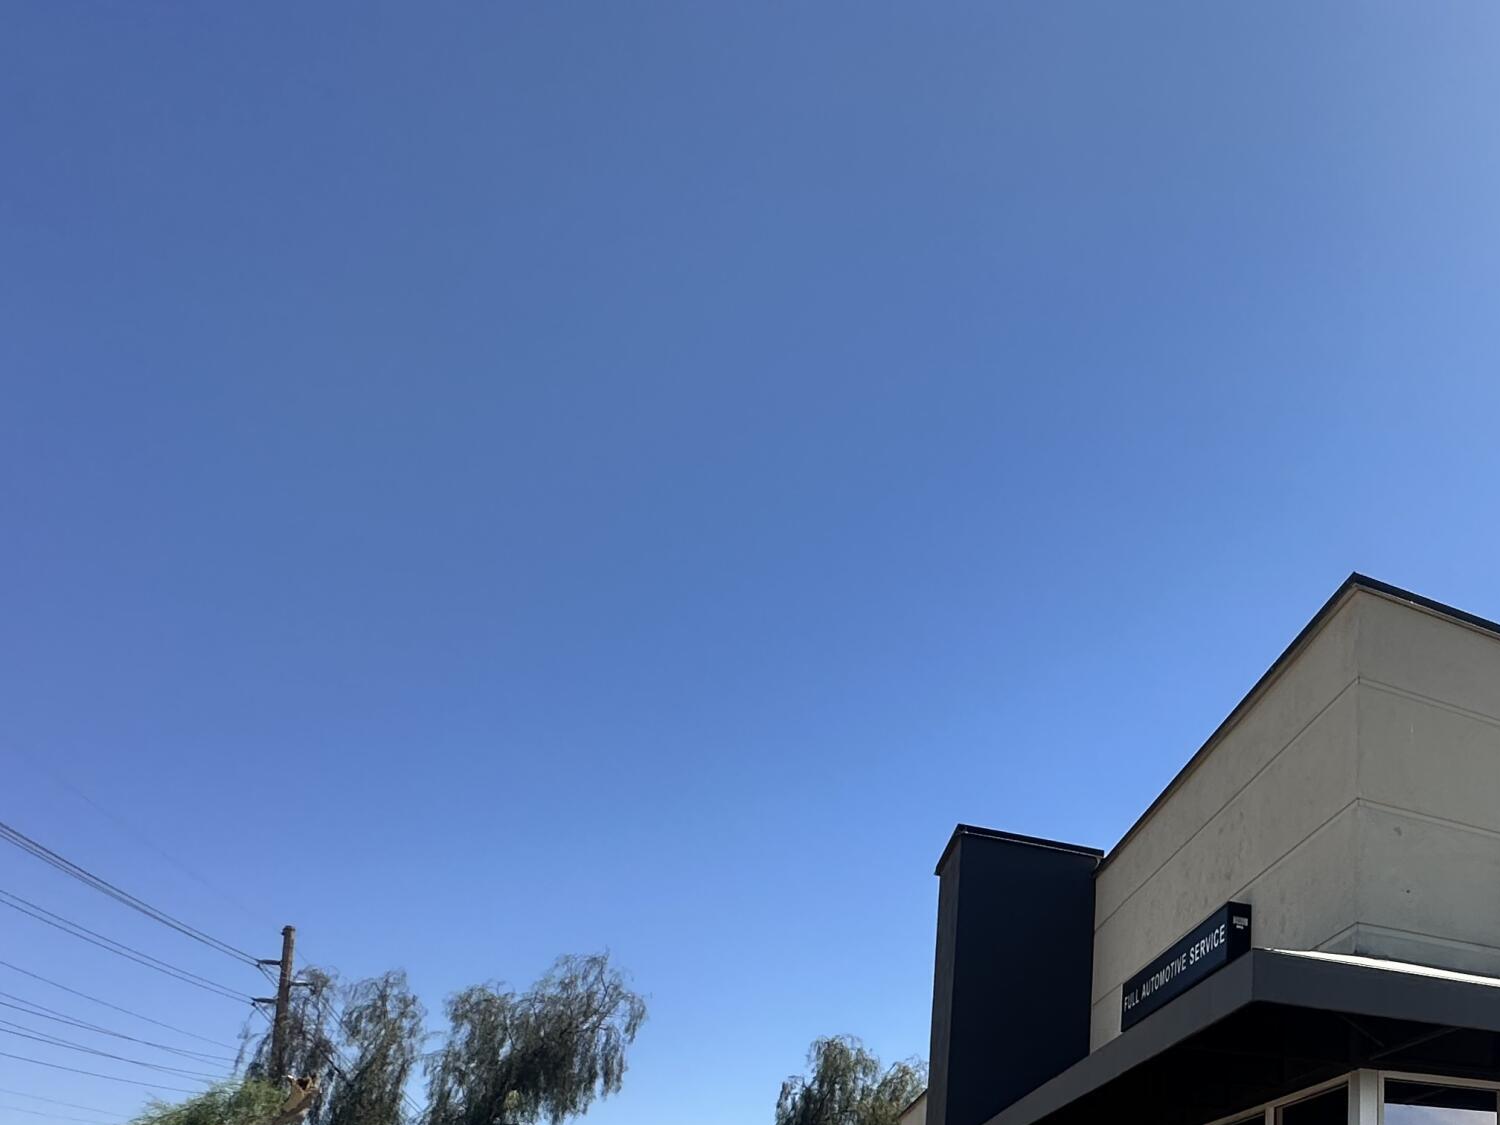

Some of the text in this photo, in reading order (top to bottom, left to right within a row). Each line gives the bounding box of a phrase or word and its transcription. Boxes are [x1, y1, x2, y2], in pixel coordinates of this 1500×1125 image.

[1123, 924, 1226, 1012] FULL AUTOMOTIVE SERVICE
